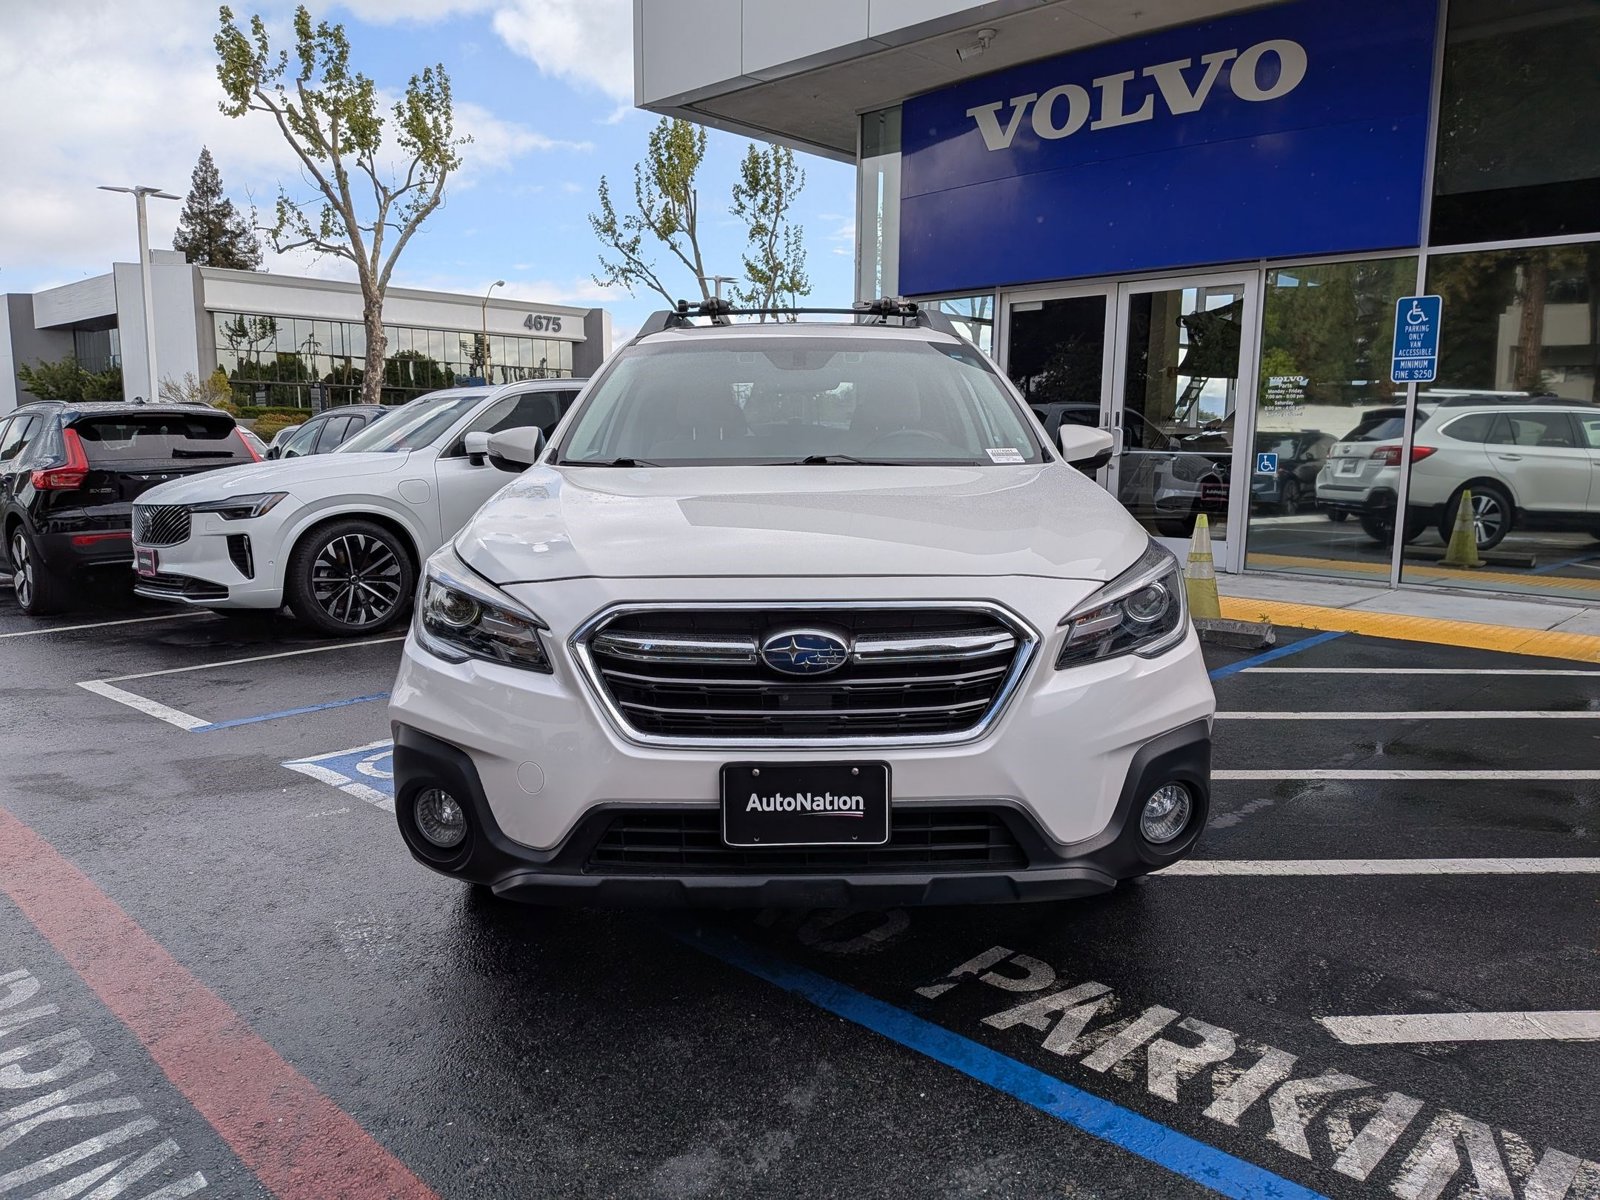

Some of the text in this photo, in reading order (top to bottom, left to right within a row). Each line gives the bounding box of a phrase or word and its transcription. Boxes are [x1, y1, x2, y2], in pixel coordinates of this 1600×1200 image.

[966, 39, 1308, 151] VOLVO
[524, 314, 562, 332] 4675
[1404, 325, 1430, 333] PARKING
[1399, 348, 1432, 356] ACCESSIBLE
[1400, 360, 1428, 369] MINIMUM
[1394, 369, 1432, 379] FINE $250
[745, 792, 864, 812] AutoNation
[914, 945, 1592, 1200] PARKIN
